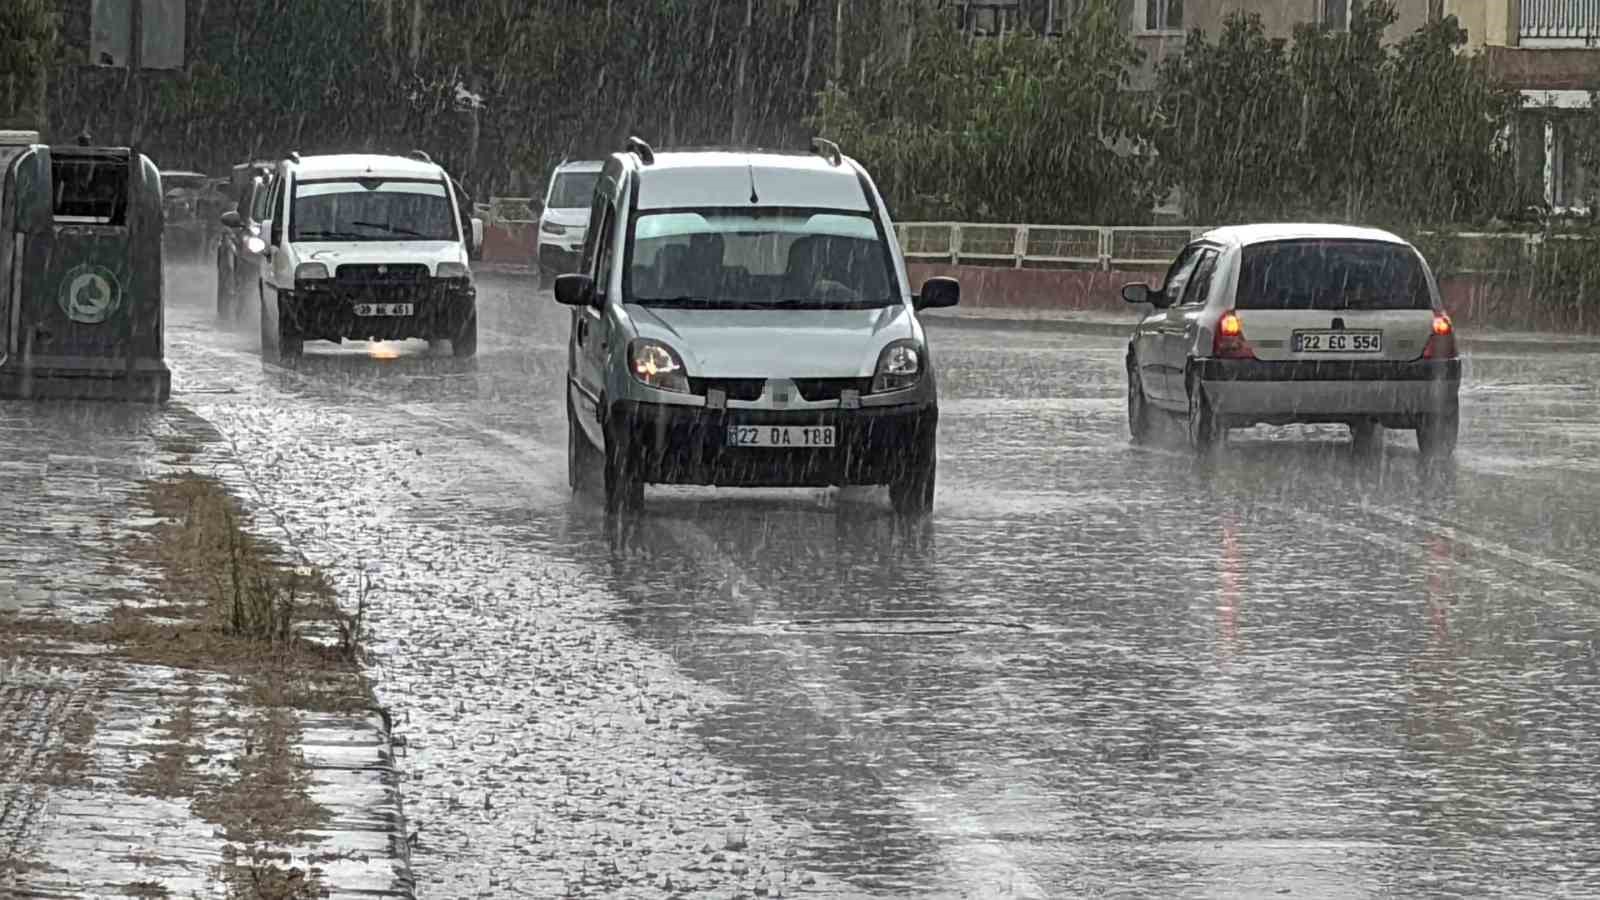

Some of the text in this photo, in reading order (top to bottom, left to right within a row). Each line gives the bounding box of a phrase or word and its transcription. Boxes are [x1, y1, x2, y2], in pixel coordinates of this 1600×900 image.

[1304, 335, 1379, 349] 22 EC 554
[739, 428, 833, 445] 22 DA 188
